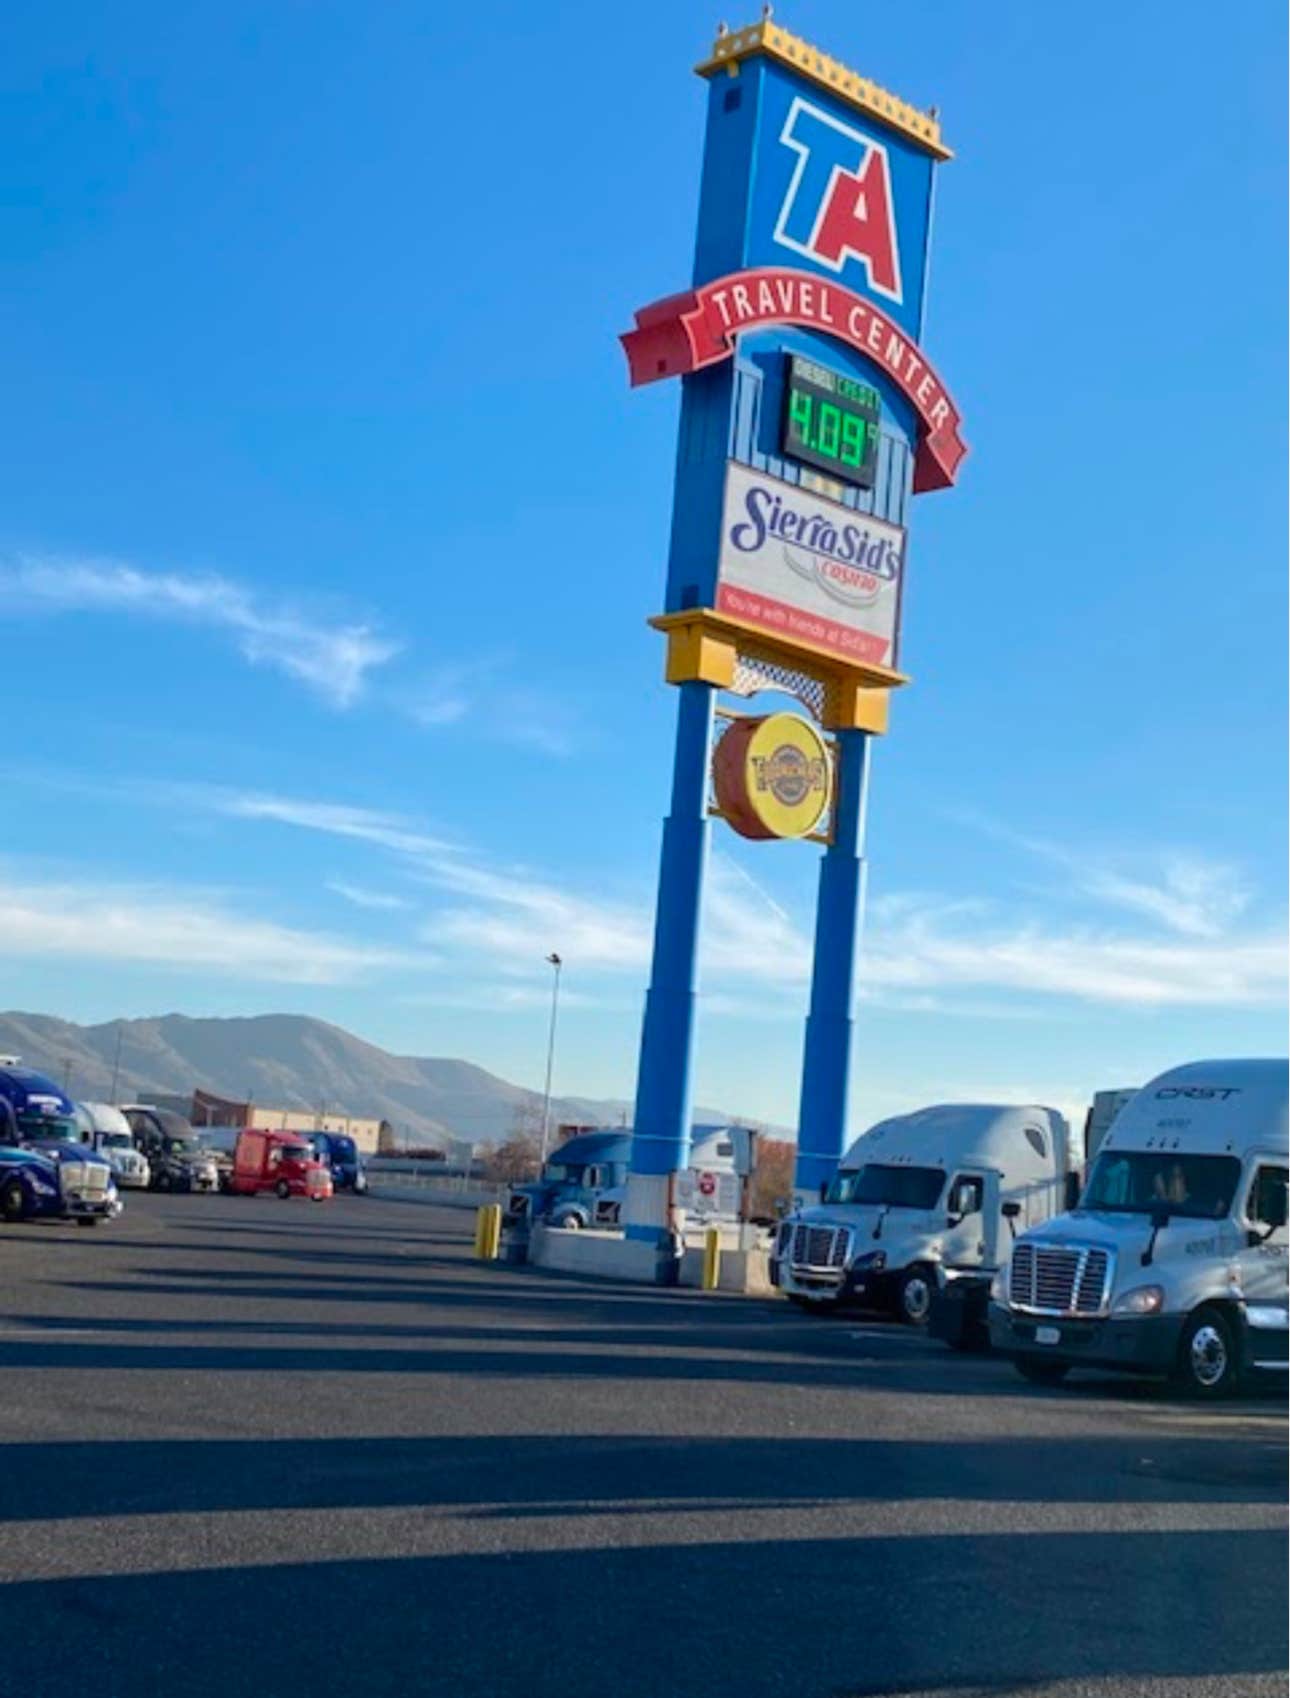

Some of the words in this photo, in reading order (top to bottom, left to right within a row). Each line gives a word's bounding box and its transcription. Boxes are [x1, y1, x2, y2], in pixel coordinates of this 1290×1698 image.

[773, 97, 903, 304] TA
[712, 278, 833, 327] TRAVEL
[849, 305, 949, 428] CENTER
[730, 486, 837, 553] Sierra
[838, 524, 901, 581] Sid's
[1155, 1087, 1243, 1101] CRST
